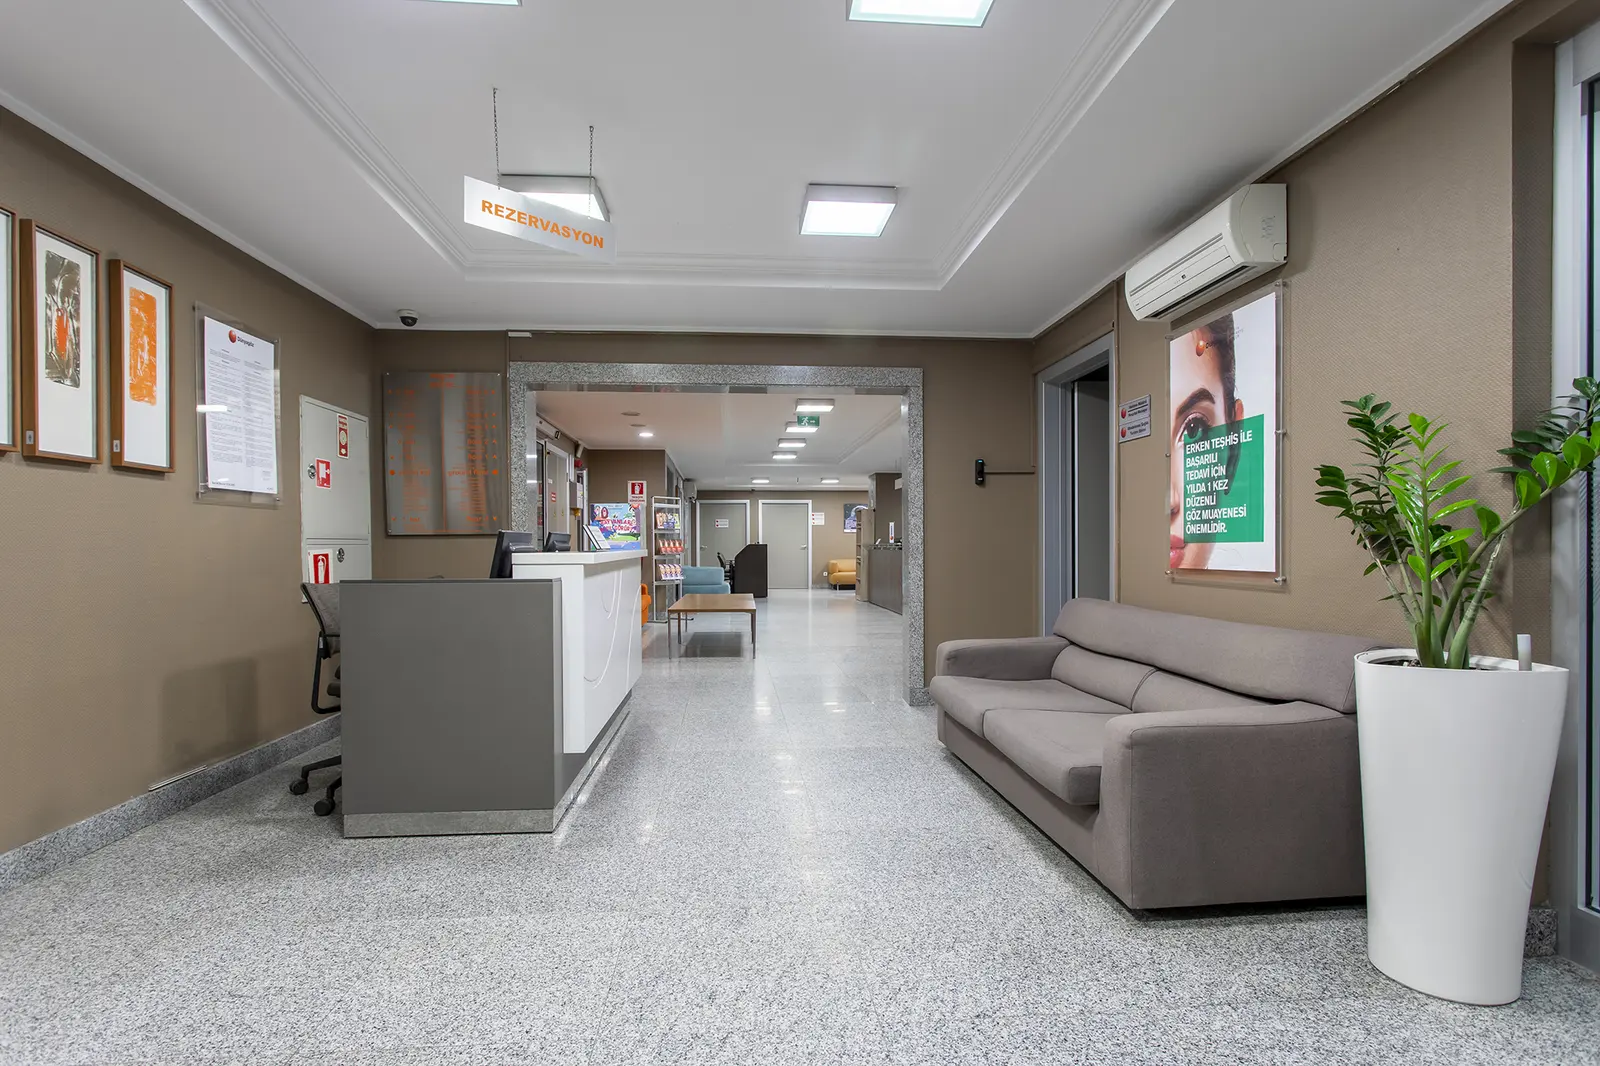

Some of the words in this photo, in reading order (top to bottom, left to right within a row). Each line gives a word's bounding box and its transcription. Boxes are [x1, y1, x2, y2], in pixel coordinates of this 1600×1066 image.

[481, 199, 604, 249] REZERVASYON
[1186, 440, 1210, 454] ERKEN
[1211, 432, 1239, 449] TEŞHİS
[1240, 430, 1253, 443] İLE
[1186, 452, 1218, 468] BAŞARILI
[1186, 465, 1210, 480] TEDAVİ
[1211, 464, 1226, 479] İÇİN
[1186, 482, 1206, 494] YILDA
[1207, 482, 1211, 492] 1
[1212, 479, 1229, 491] KEZ
[1186, 493, 1216, 507] DÜZENLİ
[1186, 508, 1201, 521] GÖZ
[1202, 504, 1247, 519] MUAYENESİ
[1186, 521, 1227, 534] ÖNEMLİDİR.
